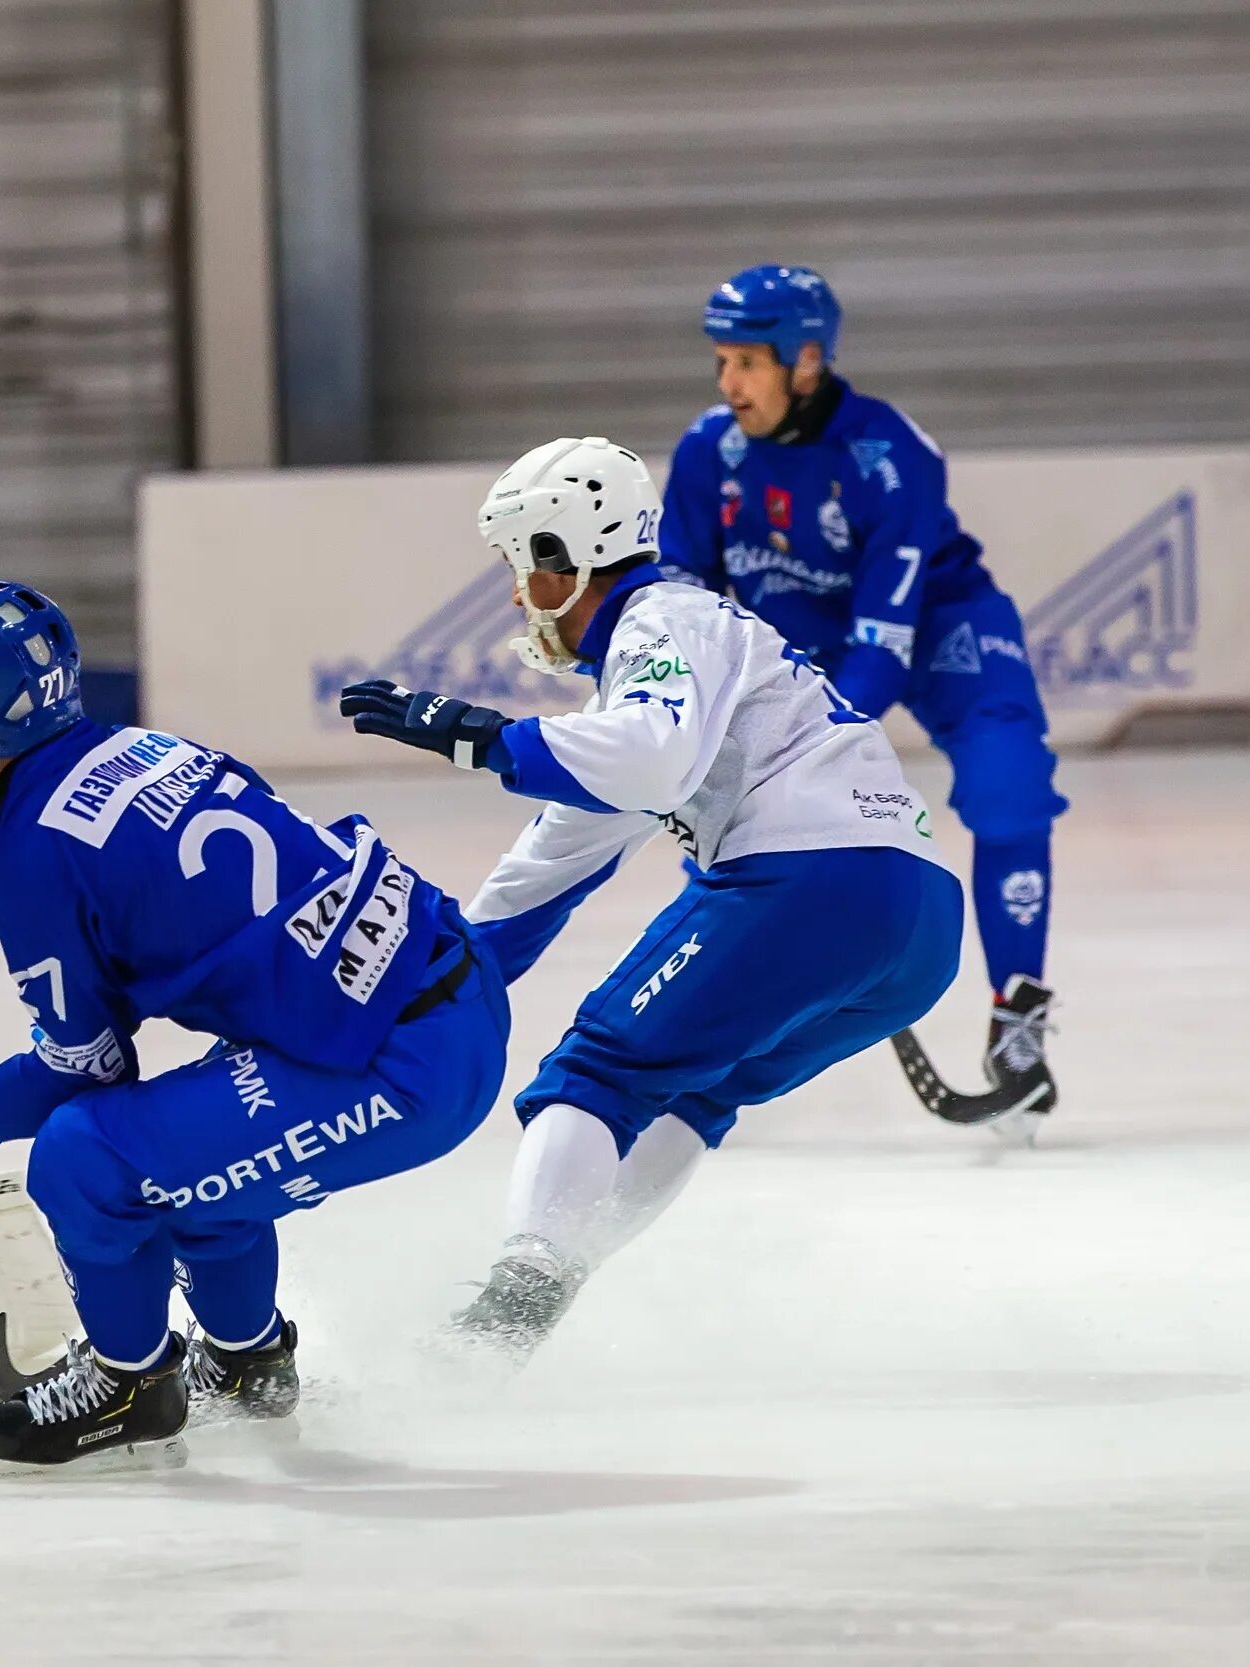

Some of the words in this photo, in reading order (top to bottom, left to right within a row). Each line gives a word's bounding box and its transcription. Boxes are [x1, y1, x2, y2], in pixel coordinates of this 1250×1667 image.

[890, 546, 922, 606] 7
[38, 666, 65, 708] 27
[420, 694, 452, 726] CM
[630, 932, 703, 1016] STEX
